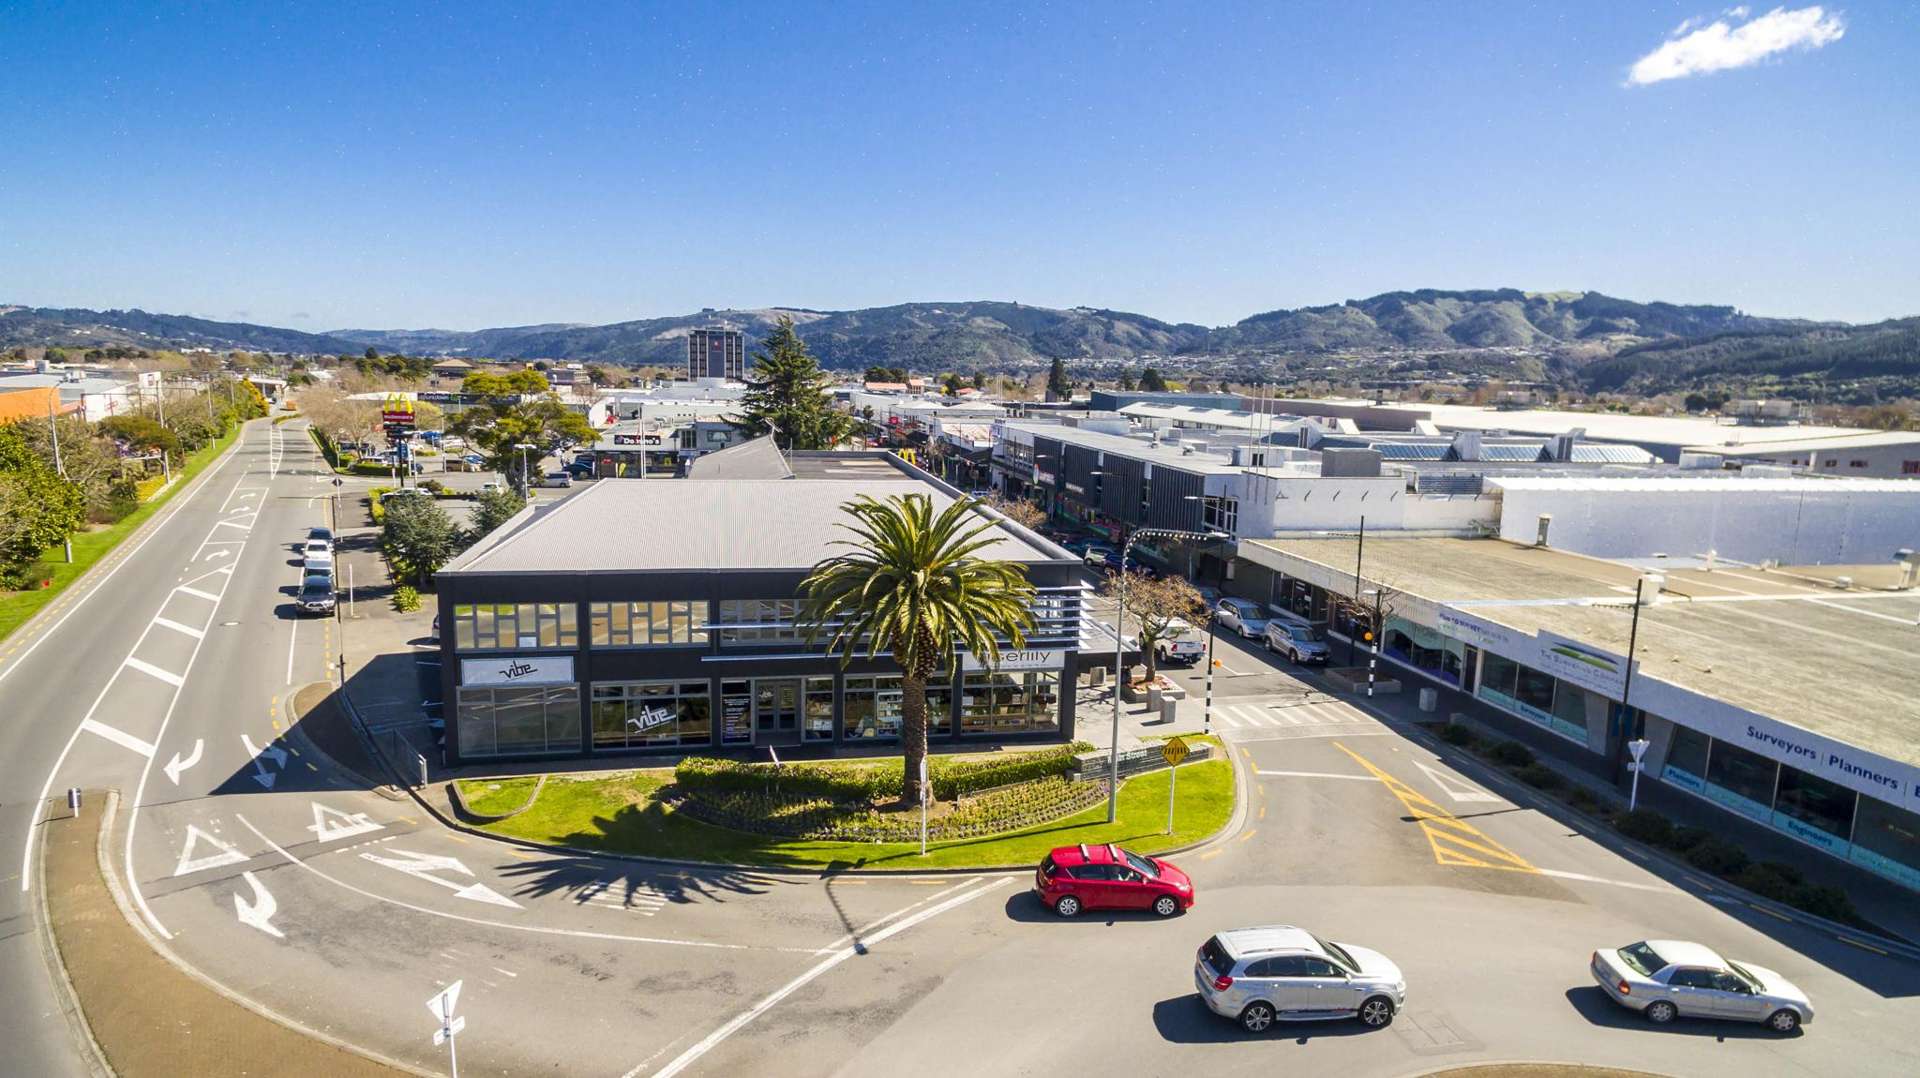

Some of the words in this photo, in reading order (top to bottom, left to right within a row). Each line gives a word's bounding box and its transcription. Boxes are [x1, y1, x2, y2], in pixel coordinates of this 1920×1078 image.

[623, 436, 660, 445] Dono's
[980, 651, 1051, 663] erlily
[499, 660, 538, 679] vibe
[627, 705, 677, 730] vibe
[1747, 725, 1817, 760] Surveyors
[1828, 754, 1899, 790] Planners
